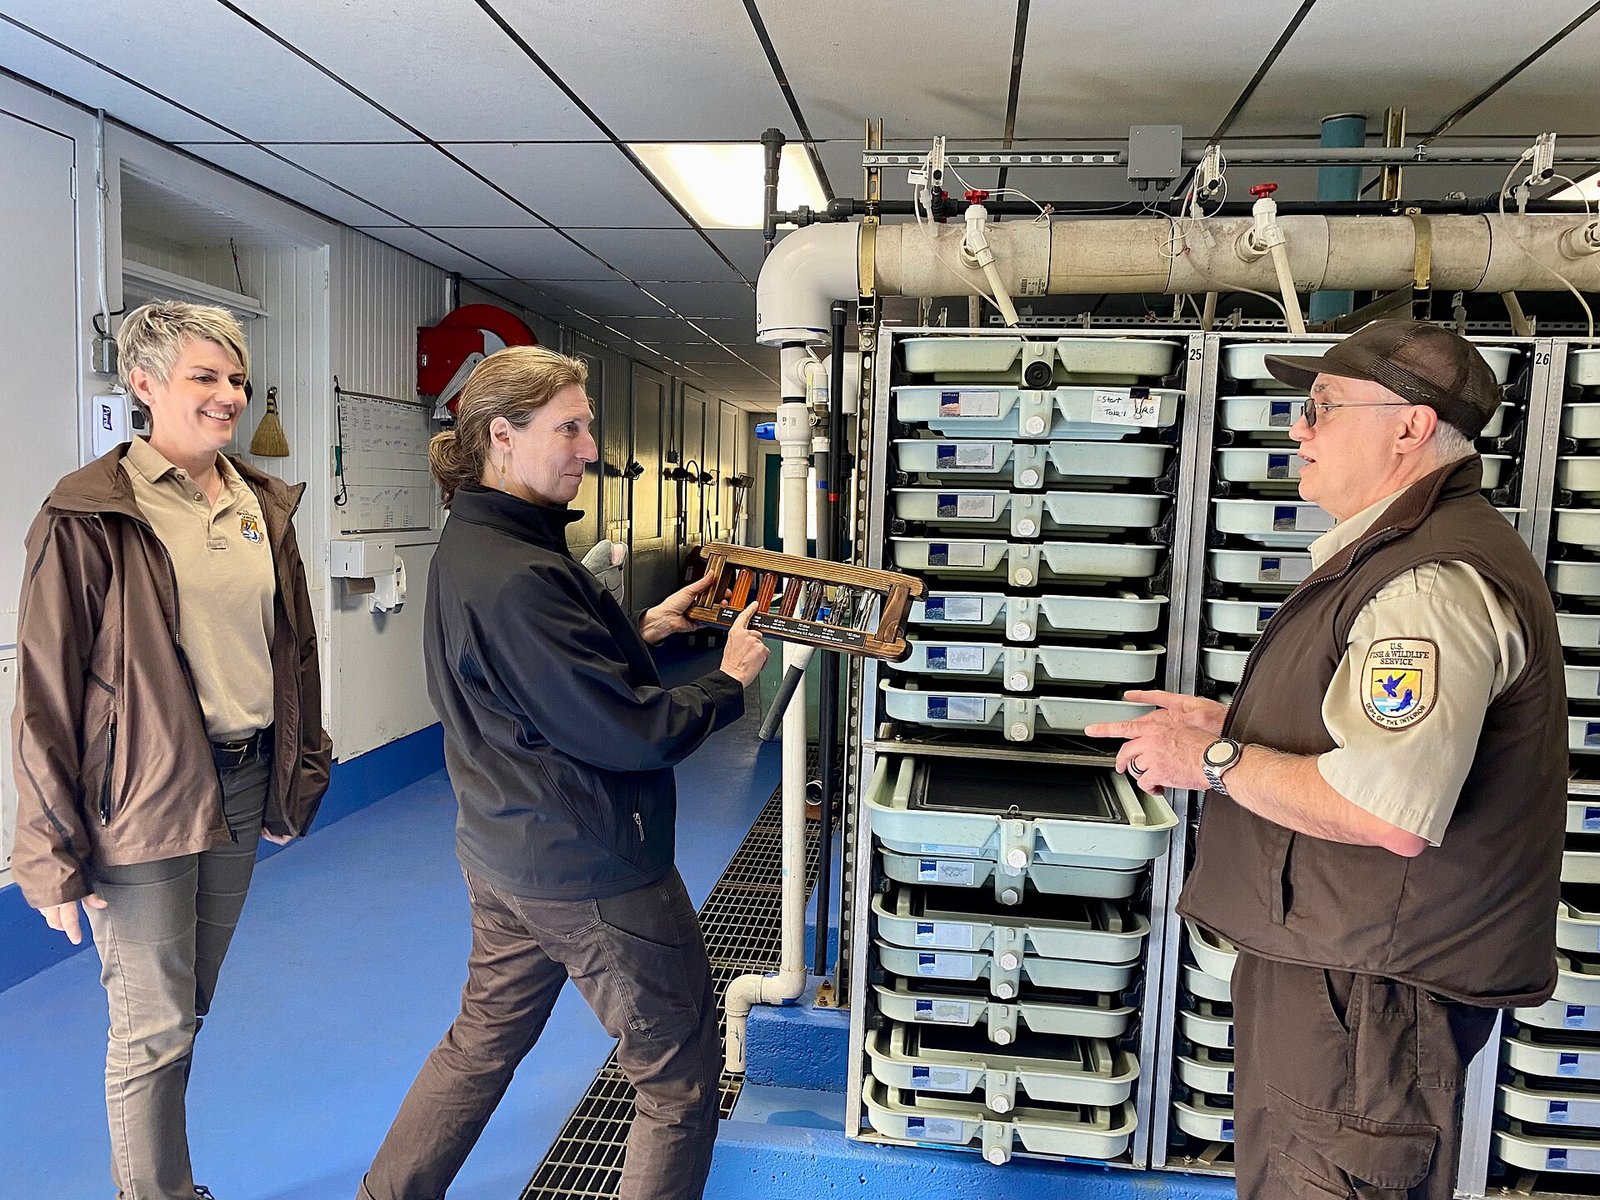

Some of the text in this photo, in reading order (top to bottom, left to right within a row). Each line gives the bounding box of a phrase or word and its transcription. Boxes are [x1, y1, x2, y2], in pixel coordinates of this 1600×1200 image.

[1189, 348, 1202, 360] 25
[1536, 352, 1550, 365] 26
[1101, 396, 1122, 404] Start
[1369, 650, 1384, 658] FISH
[1390, 650, 1430, 658] WILDLIFE
[1380, 658, 1413, 666] SERVICE
[1400, 705, 1426, 724] INTERIOR
